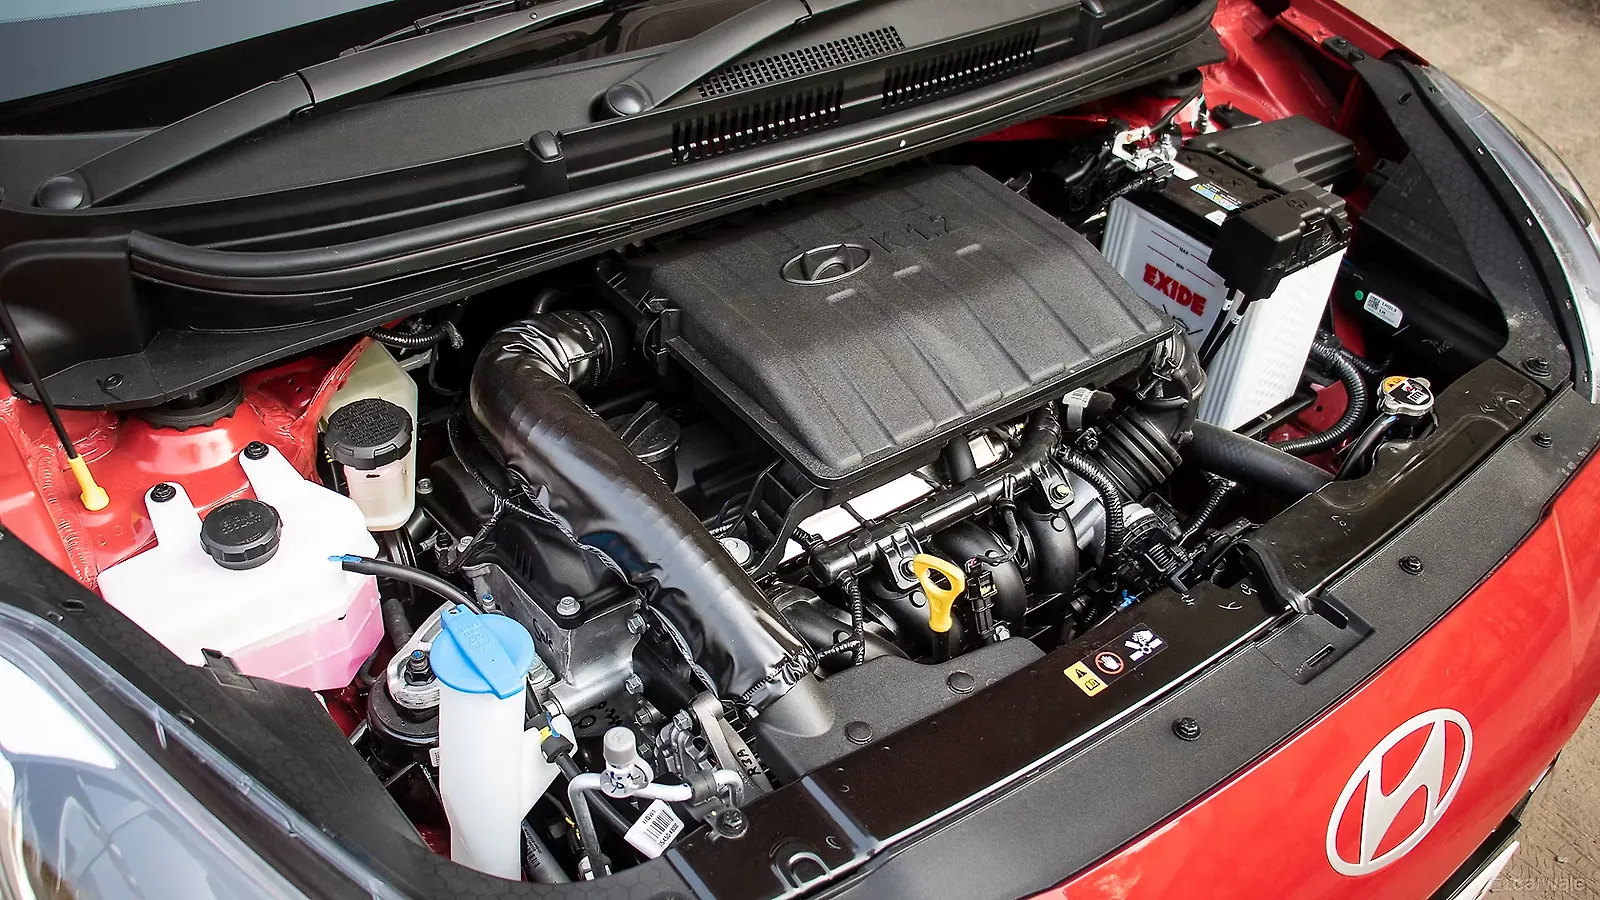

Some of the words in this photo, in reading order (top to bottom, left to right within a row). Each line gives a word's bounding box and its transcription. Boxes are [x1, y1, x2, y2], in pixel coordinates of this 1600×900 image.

[1178, 246, 1190, 256] MAX
[1175, 262, 1185, 271] MIN
[1142, 262, 1208, 317] EXIDE
